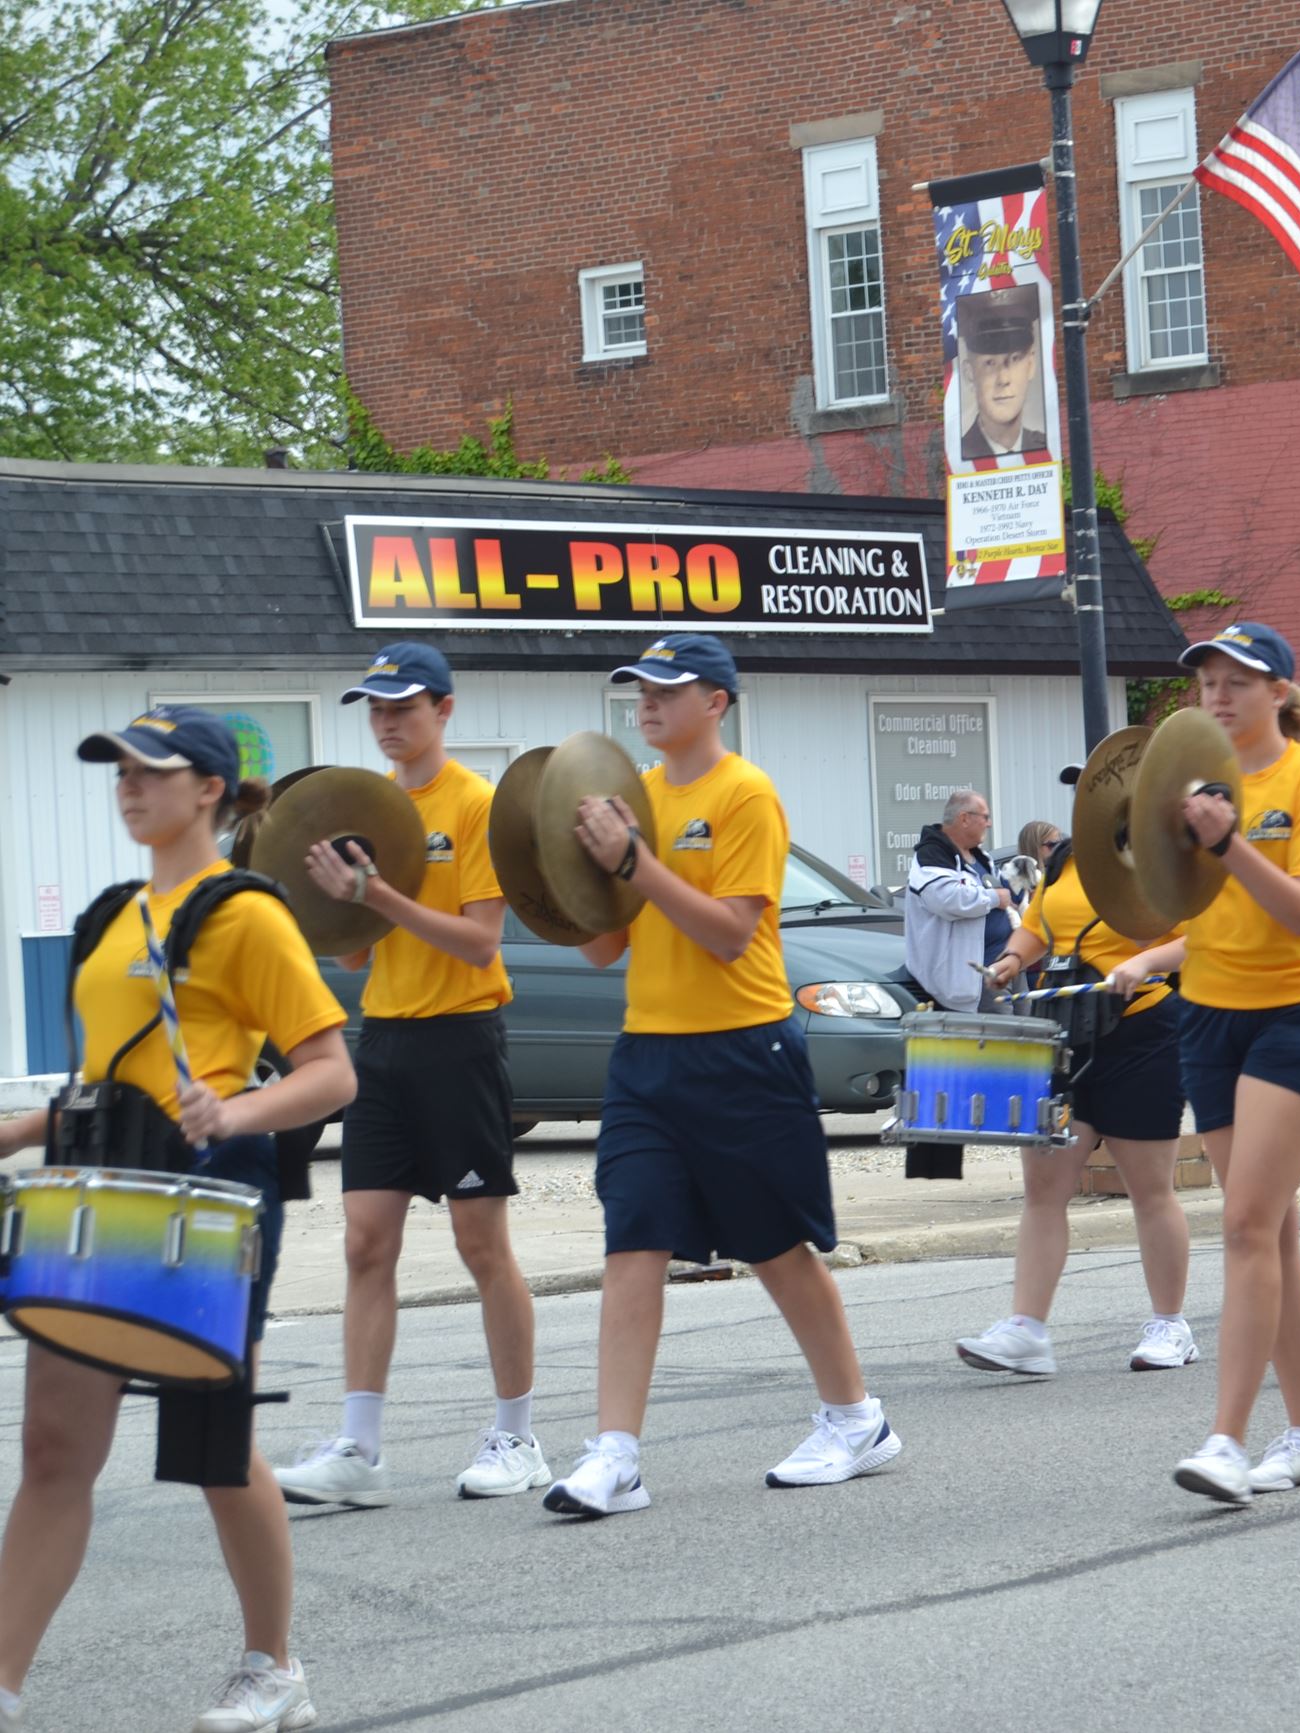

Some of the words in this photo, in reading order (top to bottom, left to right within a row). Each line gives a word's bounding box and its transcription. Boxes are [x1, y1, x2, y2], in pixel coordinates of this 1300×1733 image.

[963, 487, 1013, 504] KENNETH
[1016, 485, 1026, 498] R.
[1028, 482, 1048, 496] DAY
[1008, 501, 1019, 511] Air
[965, 533, 1000, 546] Operation
[768, 543, 885, 578] CLEANING
[890, 547, 910, 577] &
[368, 534, 742, 614] ALL-PRO
[760, 584, 923, 617] RESTORATION
[878, 714, 946, 732] Commercial
[949, 714, 983, 734] Office
[907, 736, 957, 757] Cleaning
[895, 782, 921, 801] Odor
